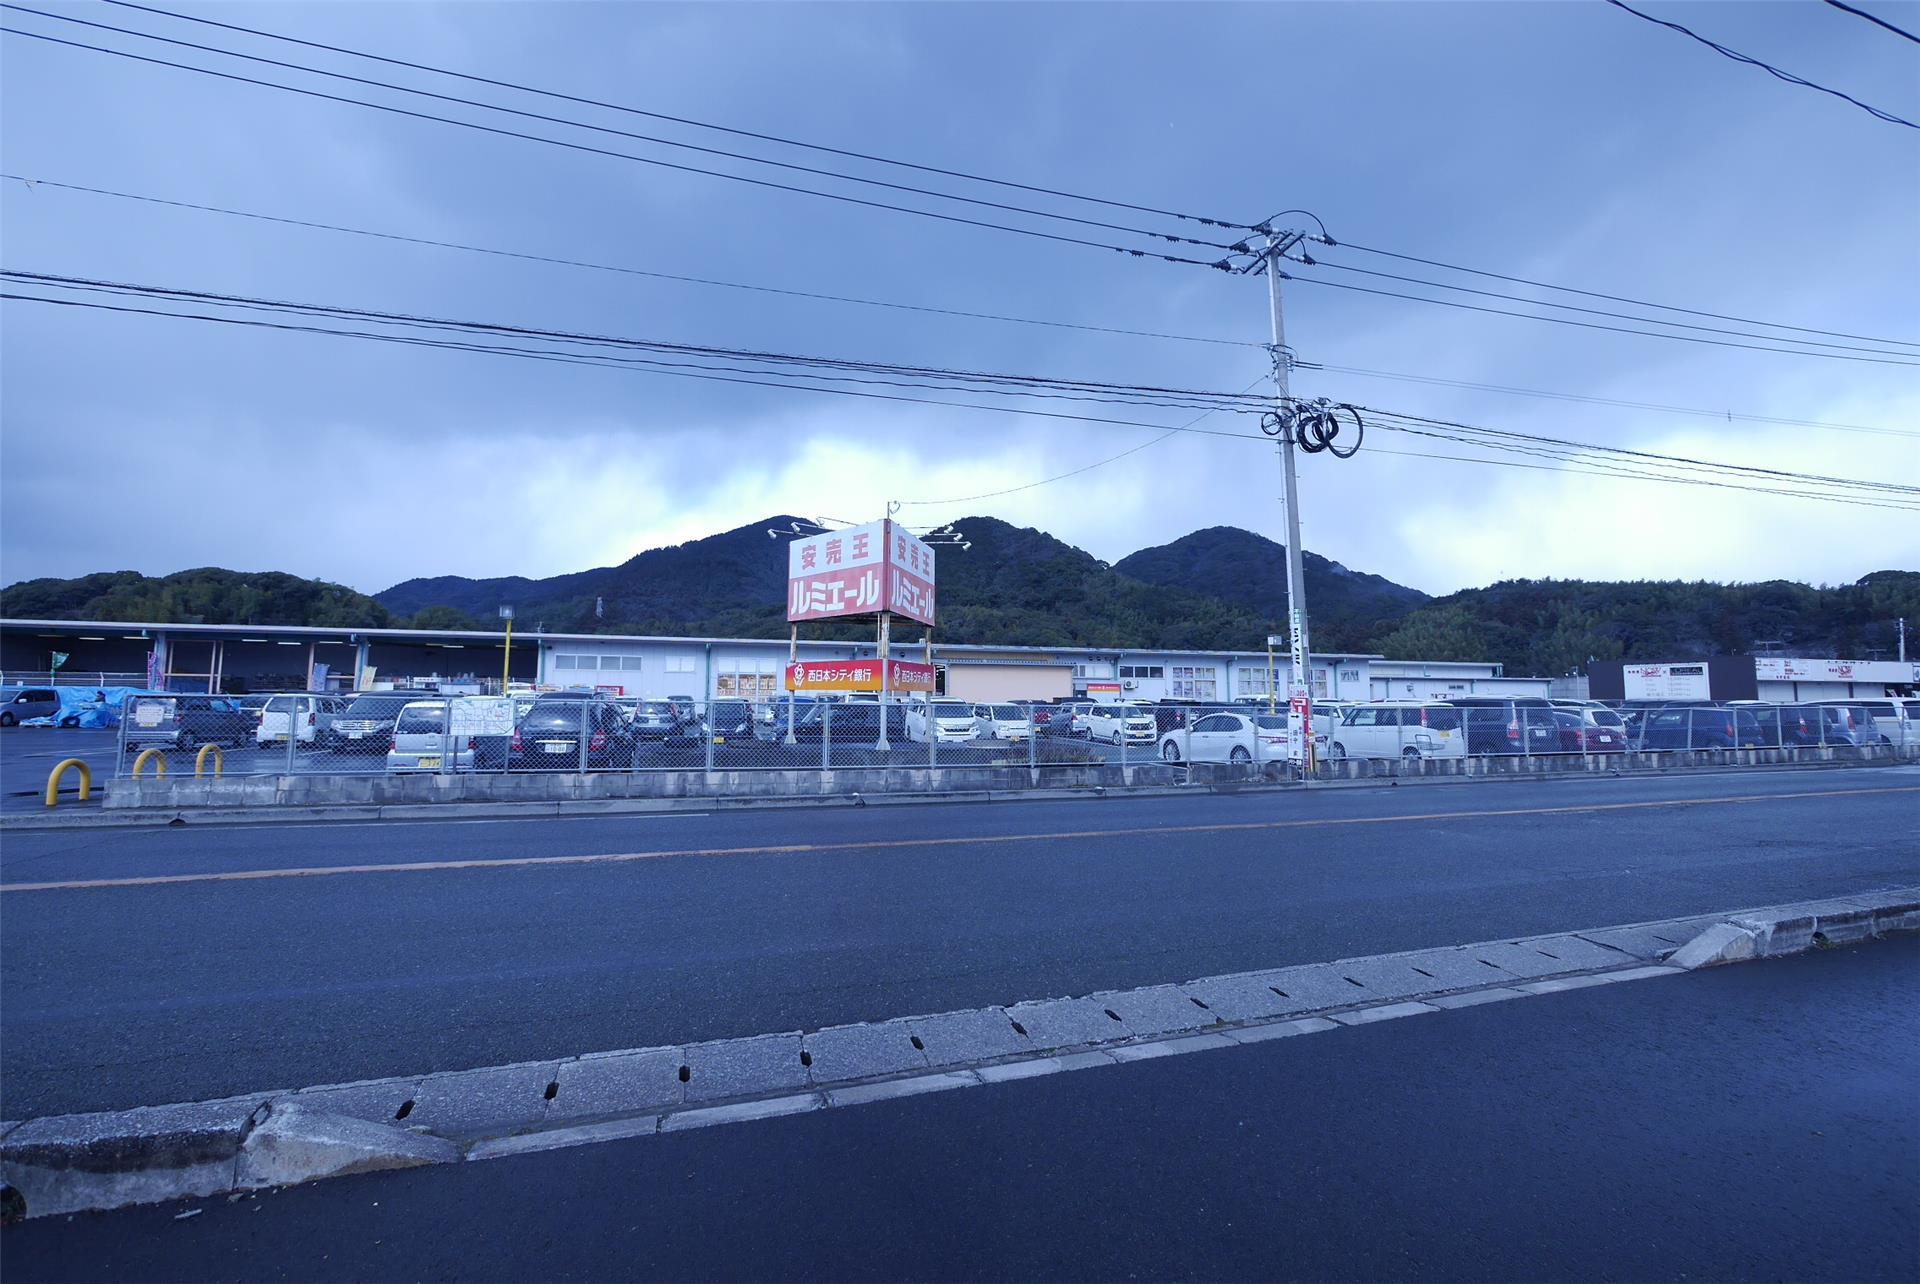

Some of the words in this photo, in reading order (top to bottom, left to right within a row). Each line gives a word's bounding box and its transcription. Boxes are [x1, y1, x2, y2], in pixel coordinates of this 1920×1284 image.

[802, 532, 869, 570] 安売王
[897, 535, 930, 577] 安売王
[791, 569, 880, 616] ルミエール
[891, 568, 934, 619] ルミエール
[807, 668, 872, 682] 西日本シティ銀行
[901, 670, 932, 684] 西日本シティ銀行
